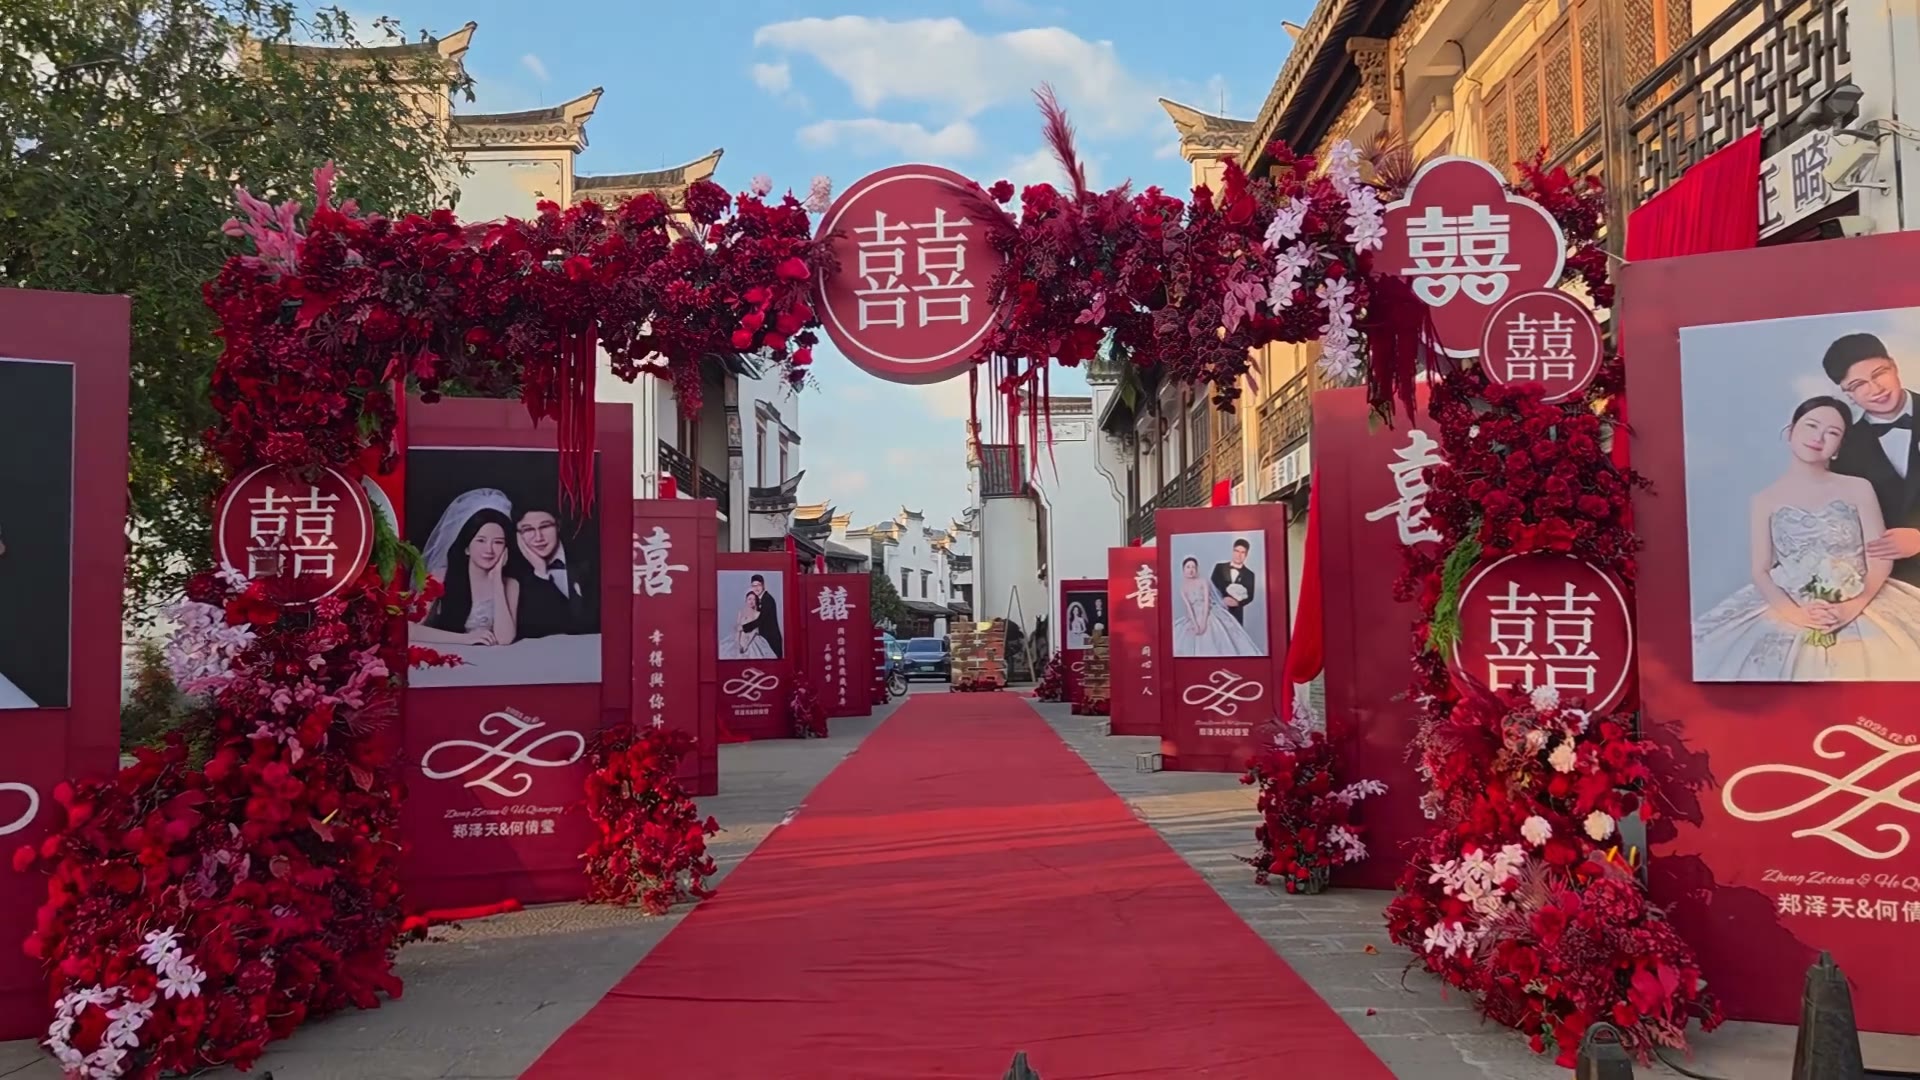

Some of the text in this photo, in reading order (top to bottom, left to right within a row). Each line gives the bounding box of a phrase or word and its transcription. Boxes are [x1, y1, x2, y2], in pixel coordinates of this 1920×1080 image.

[853, 207, 975, 331] 囍
[1505, 312, 1577, 381] 囍
[1484, 580, 1601, 694] 囍
